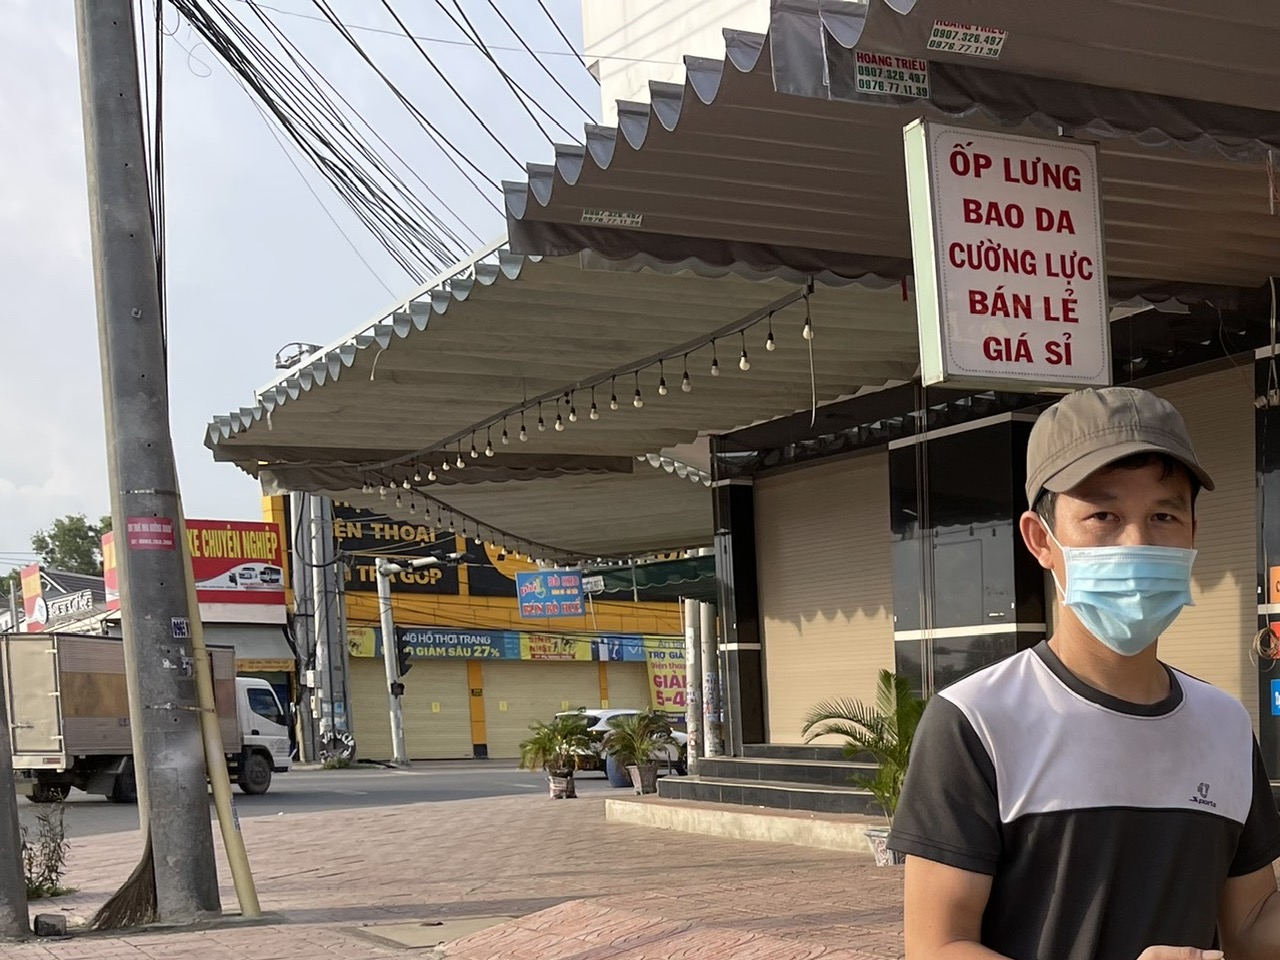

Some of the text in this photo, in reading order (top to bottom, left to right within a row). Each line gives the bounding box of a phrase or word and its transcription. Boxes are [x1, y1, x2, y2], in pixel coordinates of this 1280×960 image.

[929, 40, 999, 56] 0976.77.11.39
[933, 28, 1003, 46] 0907.326.497
[858, 65, 926, 84] 0907.326.497
[859, 78, 928, 97] 0976.77.11.39
[949, 142, 1082, 192] ỐP LƯNG
[963, 198, 1076, 235] BAO DA
[949, 239, 1093, 286] CƯỜNG LỰC
[968, 285, 1080, 323] BÁN LẺ
[983, 332, 1073, 366] GIÁ SỈ
[202, 524, 241, 558] CHUYÊN
[242, 525, 278, 566] NGHIỆP
[416, 644, 446, 656] GIẢM
[449, 644, 471, 656] SÂU
[473, 645, 500, 657] 27%
[459, 634, 491, 645] TRANG
